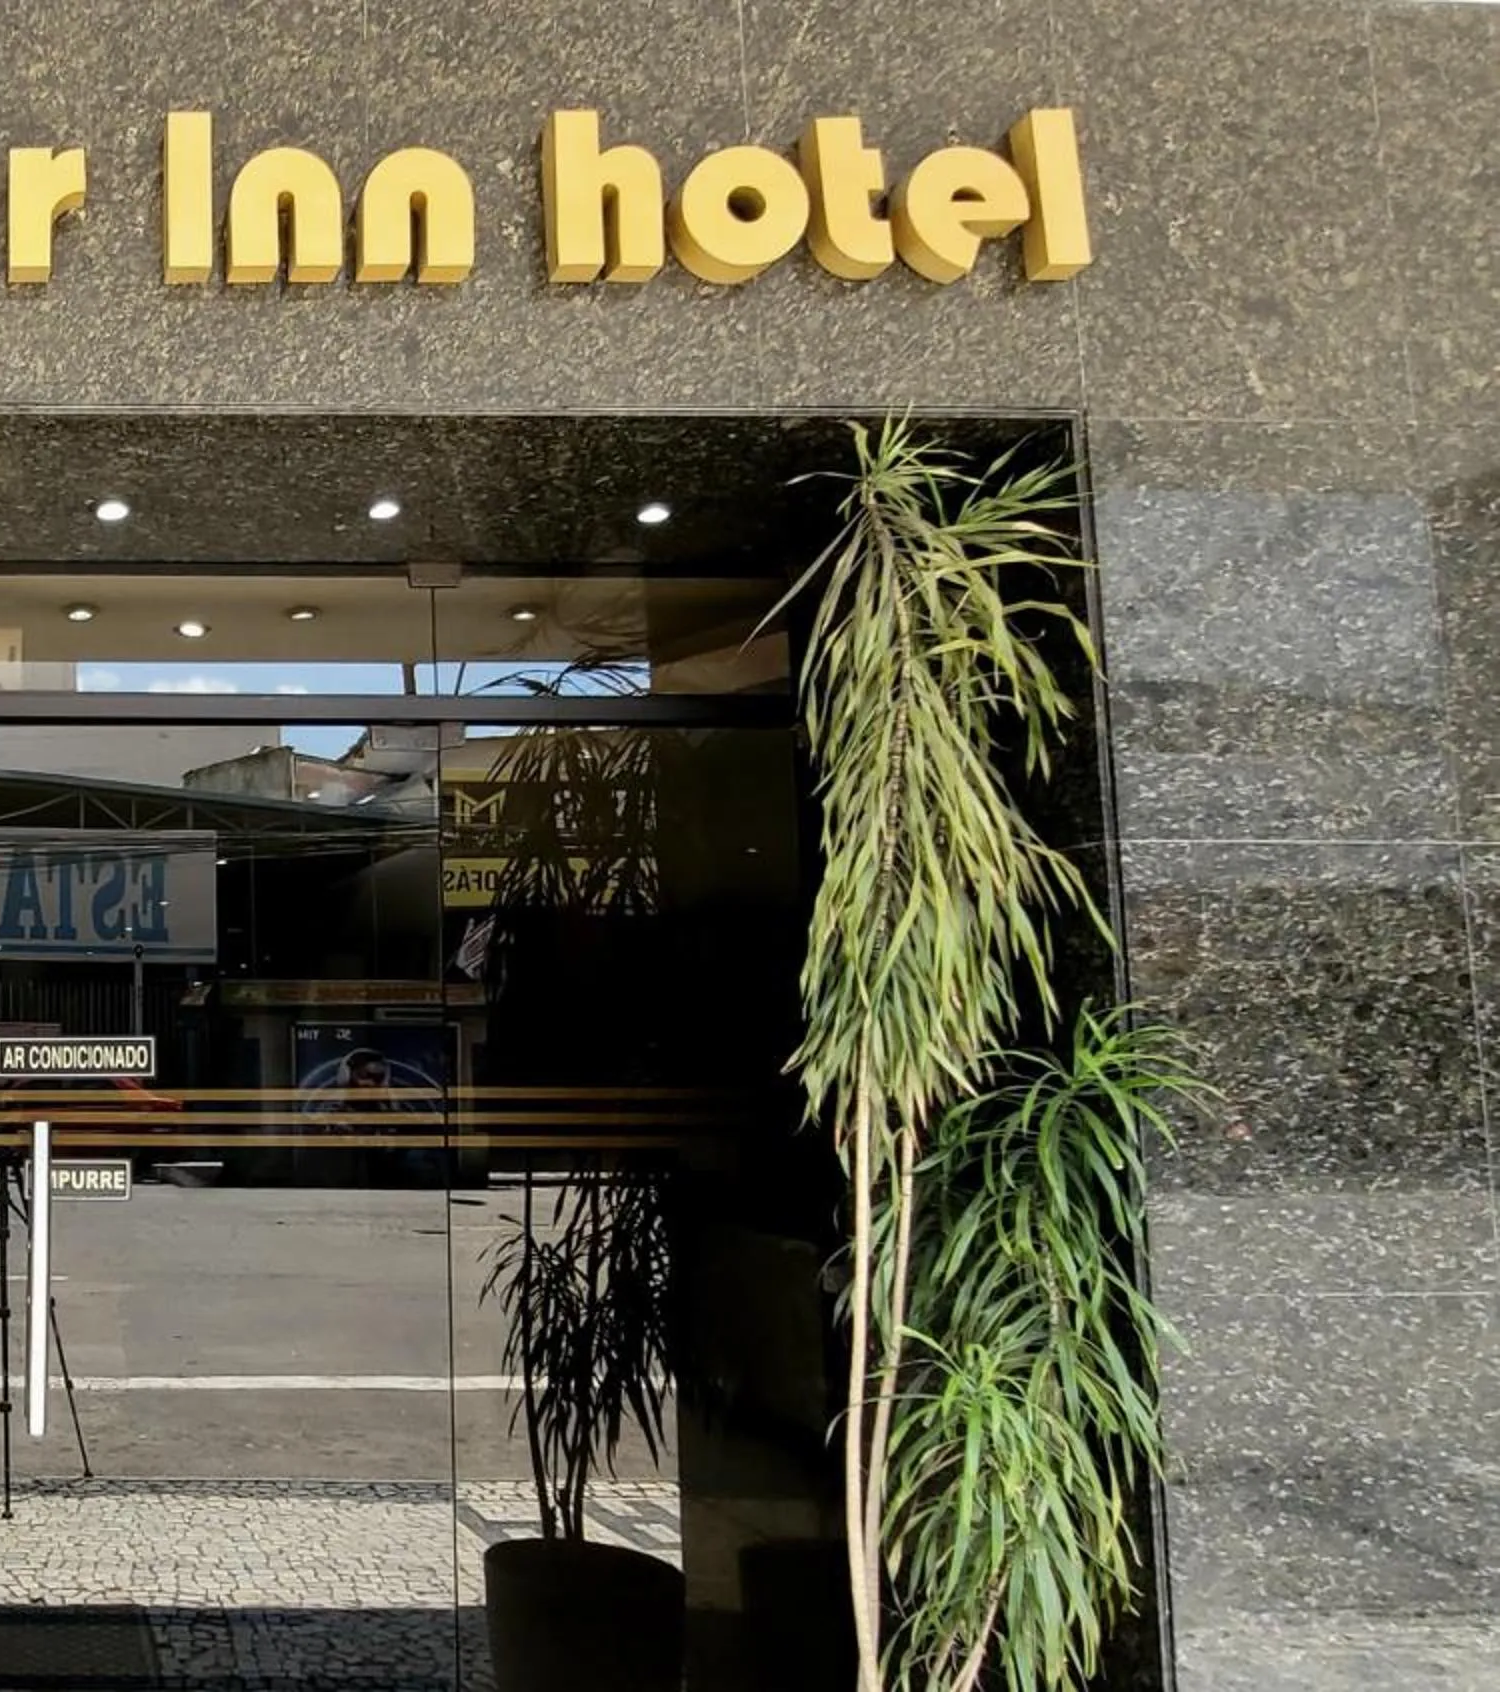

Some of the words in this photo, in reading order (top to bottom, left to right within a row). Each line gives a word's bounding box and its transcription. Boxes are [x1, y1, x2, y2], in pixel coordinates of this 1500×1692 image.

[164, 111, 475, 285] Inn
[543, 109, 1092, 286] hotel
[3, 1045, 25, 1069] AR
[29, 1044, 148, 1069] CONDICIONADO
